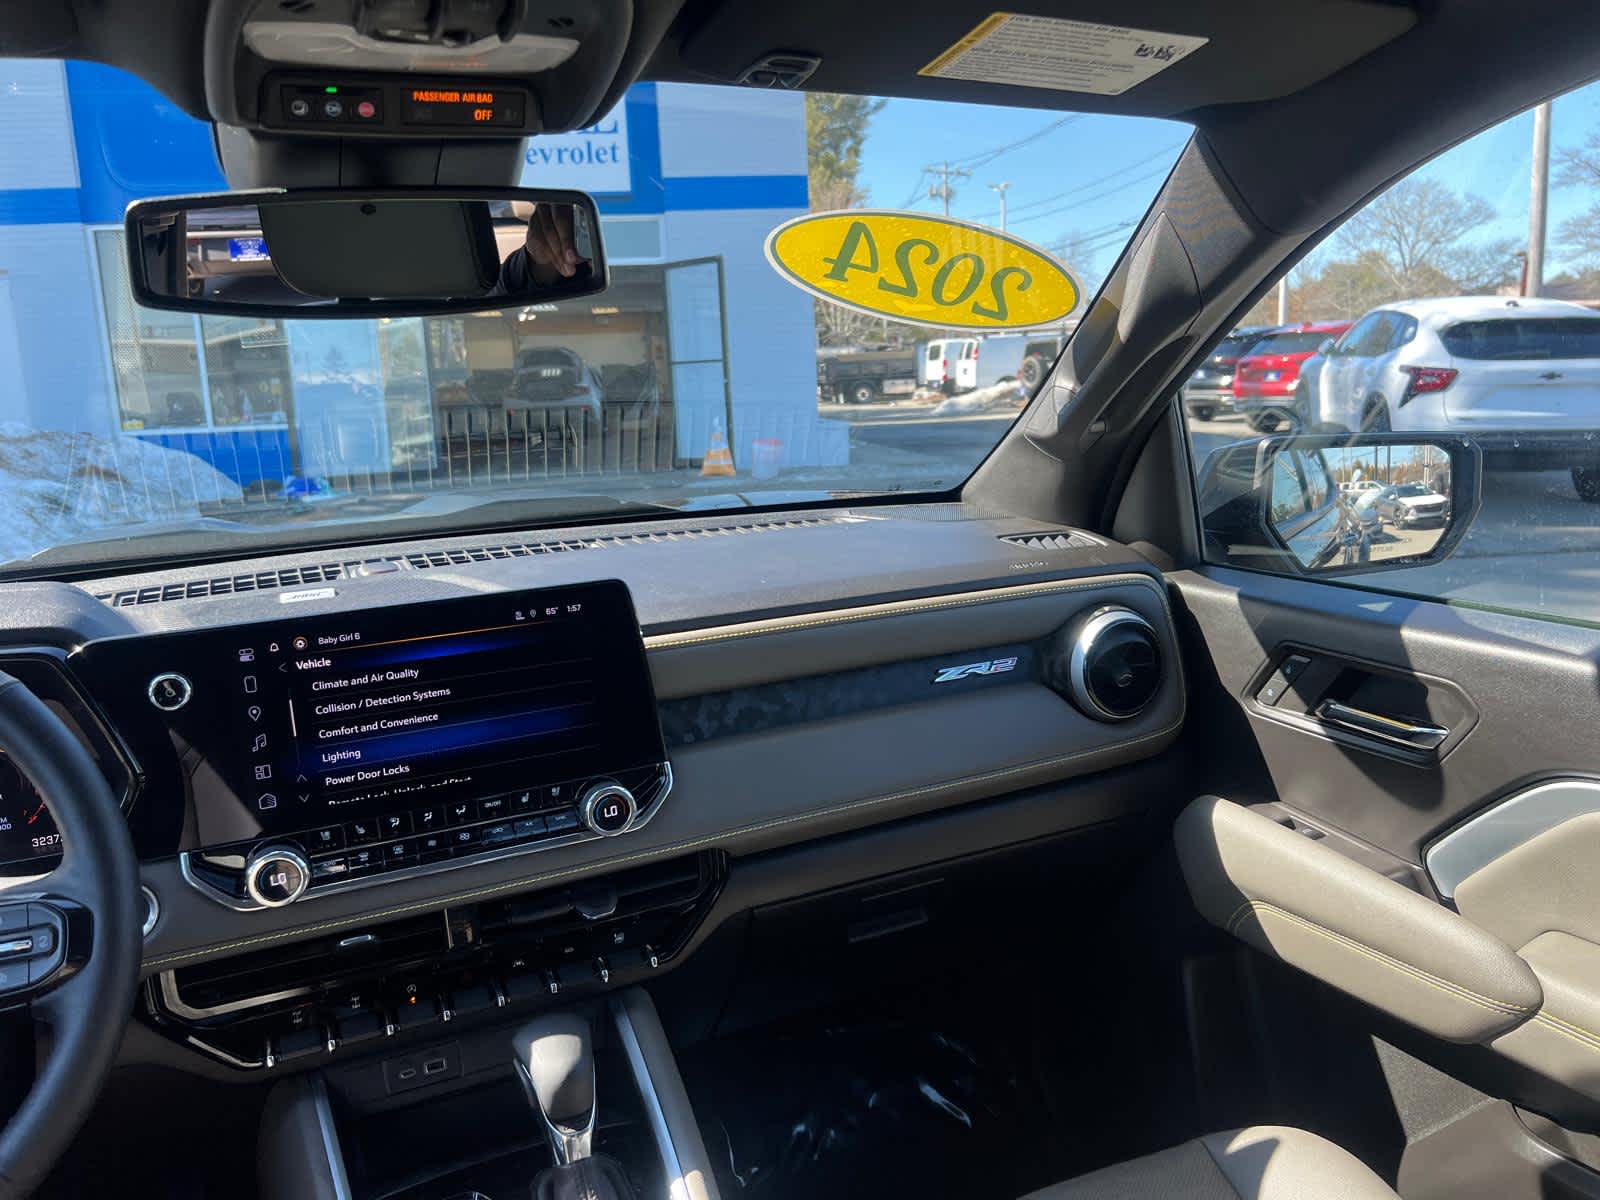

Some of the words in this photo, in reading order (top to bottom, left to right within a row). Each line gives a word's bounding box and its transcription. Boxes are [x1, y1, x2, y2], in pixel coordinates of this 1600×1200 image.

[413, 91, 460, 102] PASSENGER
[463, 92, 476, 103] AIR
[474, 108, 493, 120] OFF
[526, 140, 619, 165] evrolet
[318, 636, 338, 645] Baby
[339, 633, 354, 642] Girl
[296, 658, 332, 670] Vehicle
[934, 657, 1018, 683] ZR2
[312, 678, 349, 691] Climate
[350, 675, 369, 686] and
[370, 673, 385, 683] Air
[386, 669, 419, 681] Quality
[315, 701, 357, 715] Collision
[365, 694, 411, 707] Detection
[412, 688, 451, 701] Systems
[318, 725, 359, 739] Comfort
[360, 721, 379, 732] and
[380, 713, 439, 729] Convenience
[322, 749, 361, 764] Lighting
[325, 774, 356, 786] Power
[357, 770, 381, 781] Door
[383, 764, 410, 776] Locks
[604, 805, 618, 818] LO
[32, 833, 63, 847] 3237
